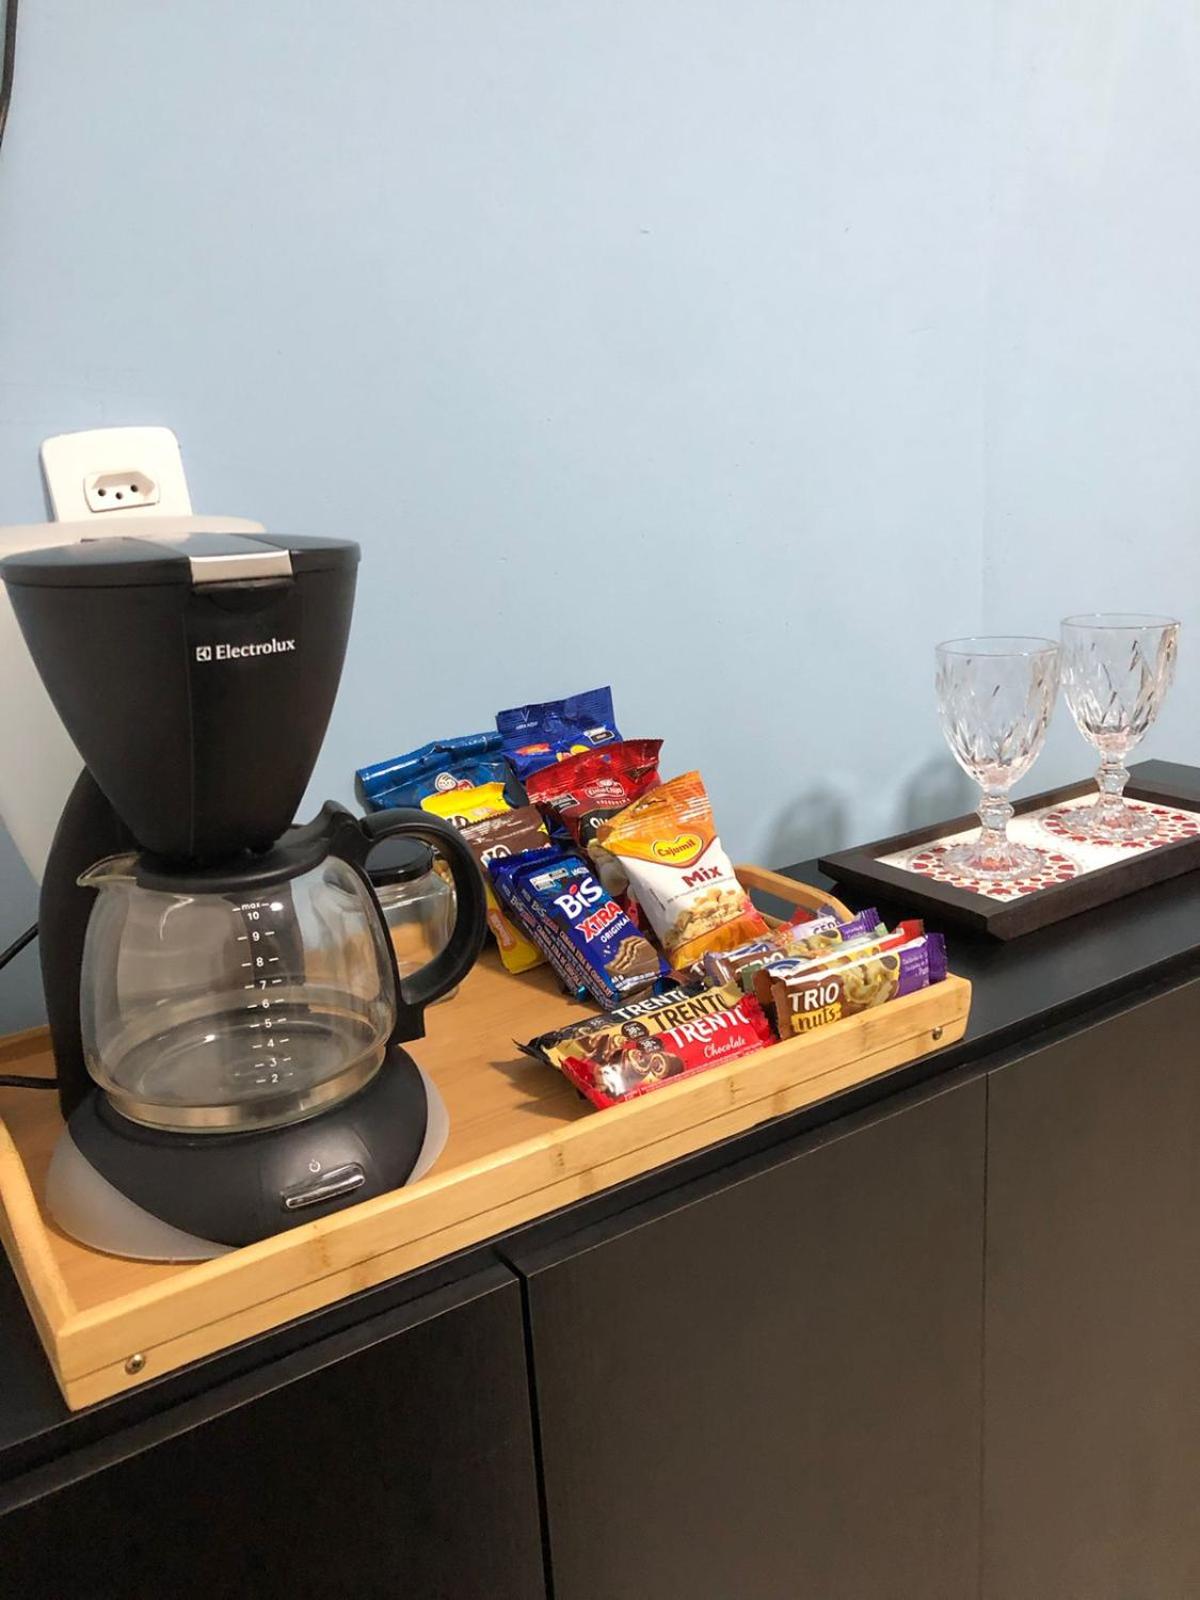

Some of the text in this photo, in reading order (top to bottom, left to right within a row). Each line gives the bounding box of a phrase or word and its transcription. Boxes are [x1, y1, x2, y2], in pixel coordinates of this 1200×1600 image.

[215, 638, 296, 660] Electrolux
[656, 839, 697, 856] Cajumil
[681, 866, 722, 888] Mix
[241, 902, 260, 911] max
[247, 911, 260, 921] 10
[575, 901, 624, 943] XTRA
[251, 931, 260, 942] 9
[256, 957, 264, 967] 8
[259, 980, 267, 990] 7
[787, 982, 840, 1012] TRIO
[262, 998, 270, 1009] 6
[264, 1018, 272, 1028] 5
[798, 1007, 836, 1031] nuts
[267, 1038, 275, 1048] 4
[703, 1035, 746, 1058] Chocolate
[269, 1057, 277, 1067] 3
[271, 1073, 279, 1083] 2
